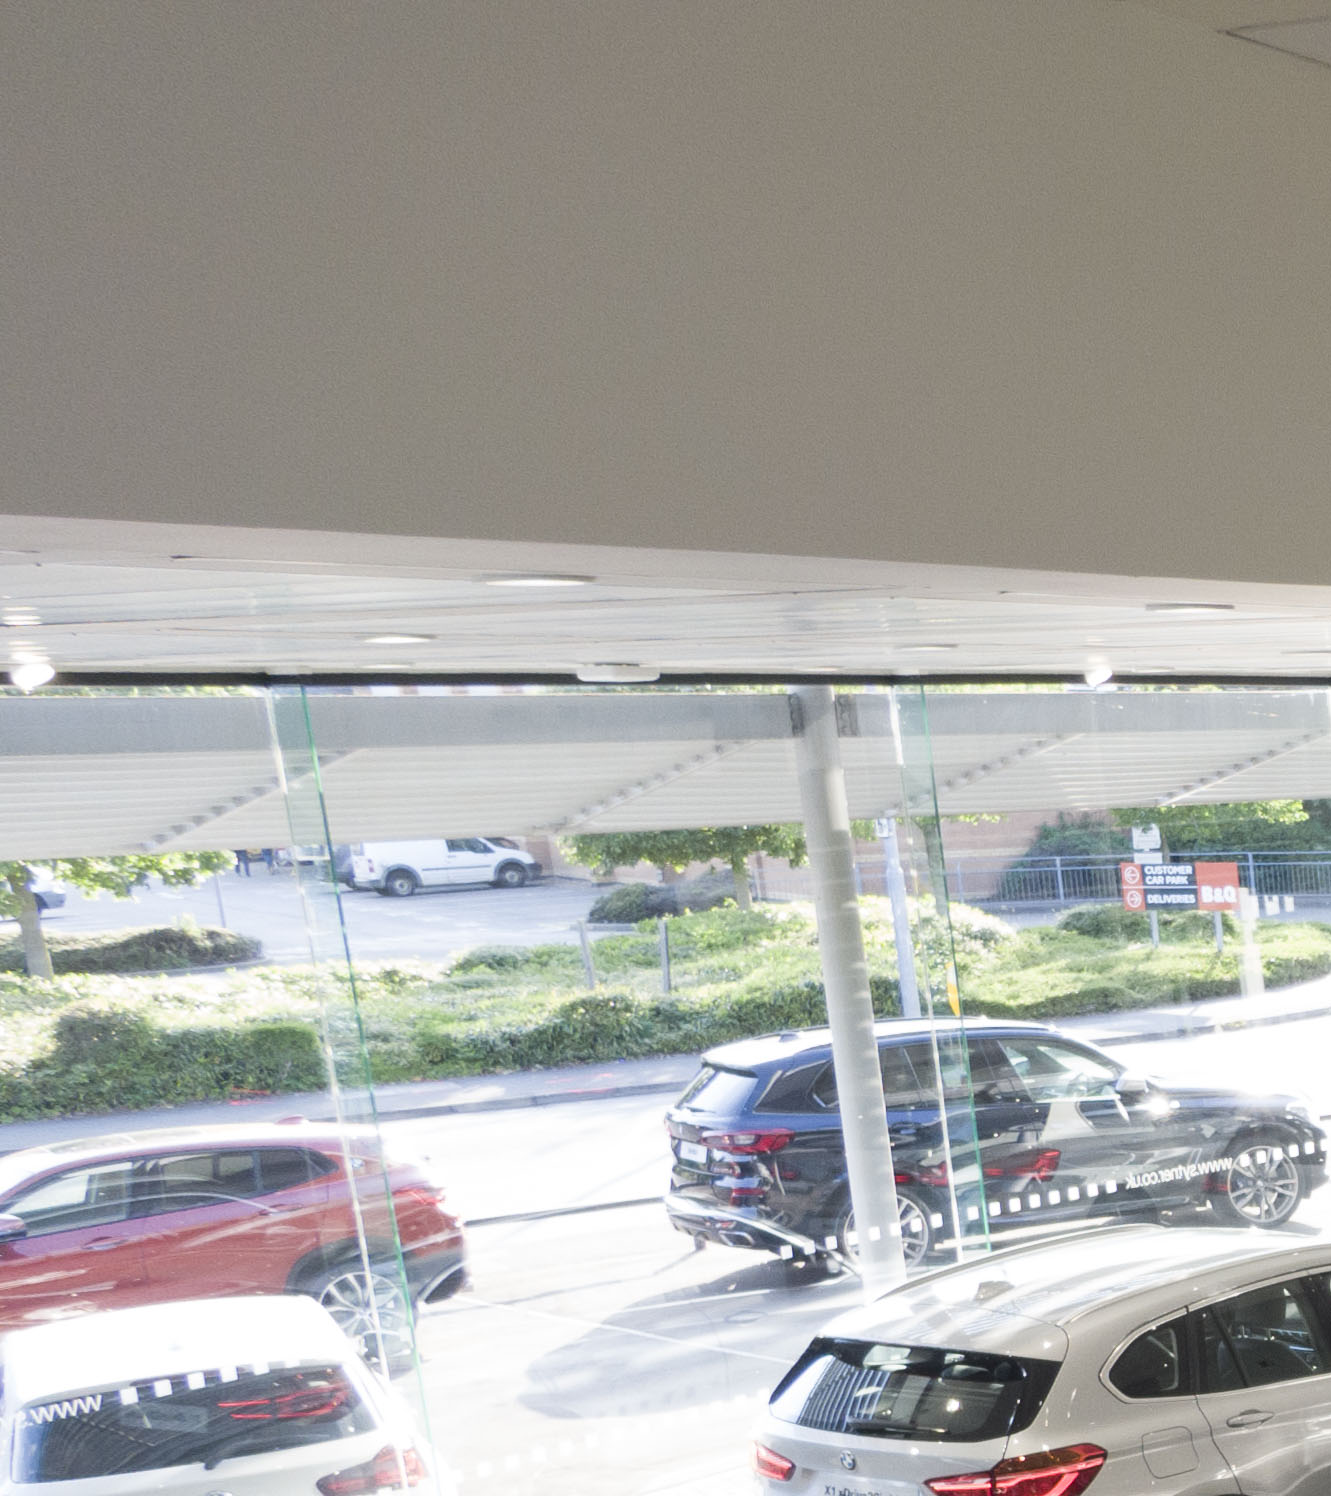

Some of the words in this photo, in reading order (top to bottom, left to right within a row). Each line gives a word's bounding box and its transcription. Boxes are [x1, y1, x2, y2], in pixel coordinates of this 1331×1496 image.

[1144, 865, 1193, 876] CUSTOMER
[1145, 875, 1164, 885] CAR
[1166, 875, 1189, 885] PARK
[1147, 894, 1196, 904] DELIVERIES
[1200, 885, 1237, 903] B&Q
[824, 1484, 836, 1496] X1
